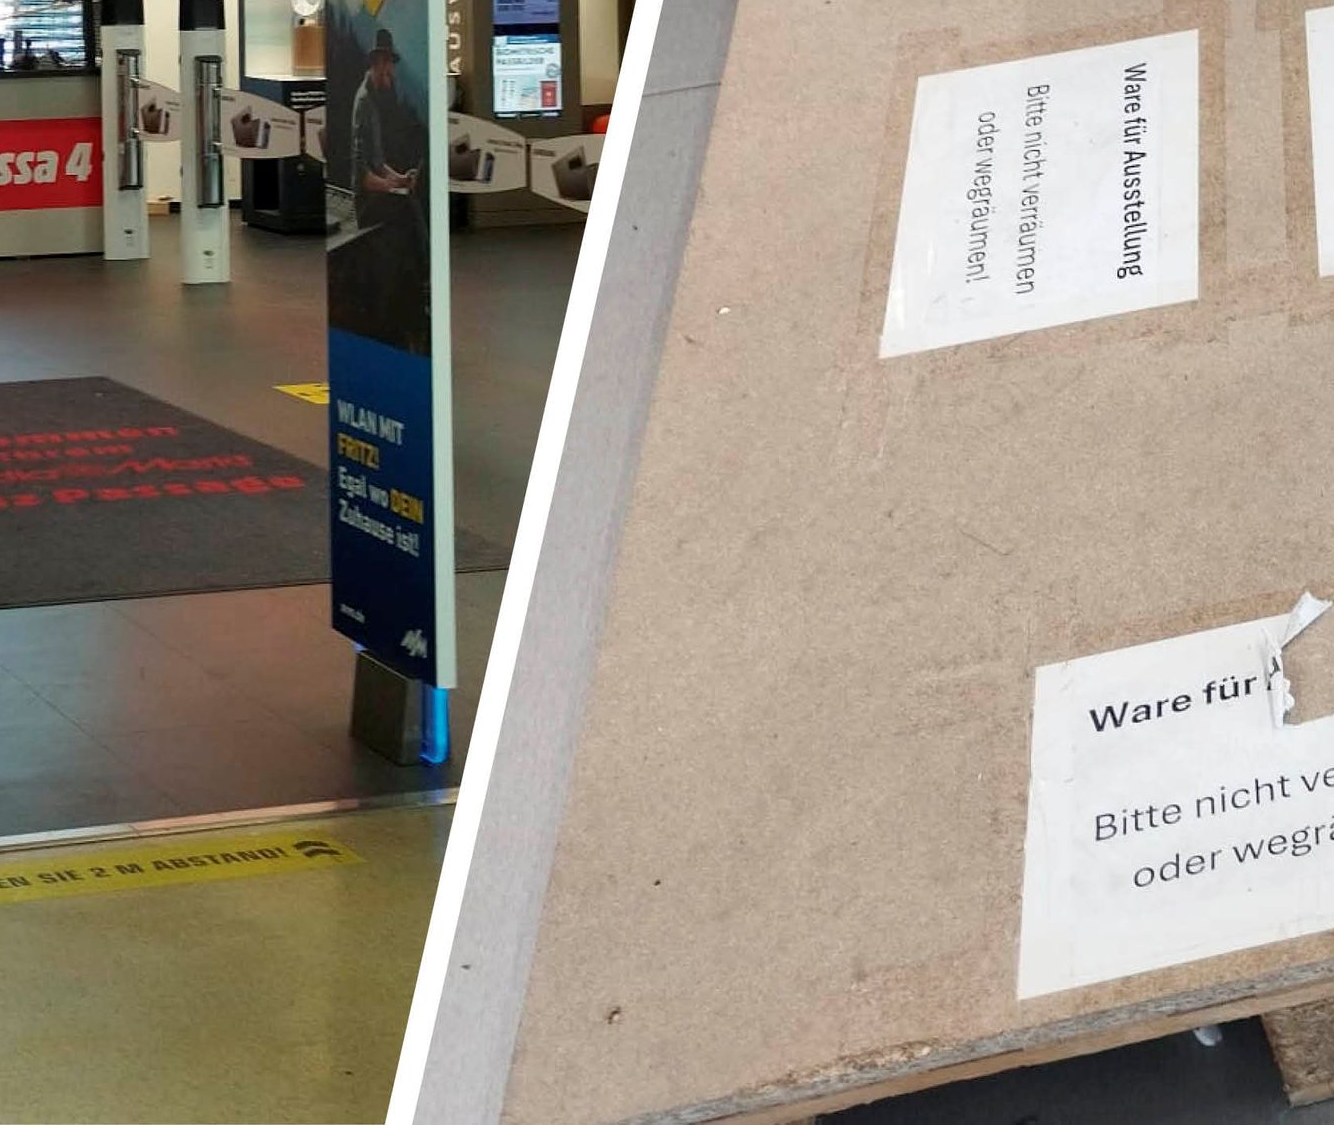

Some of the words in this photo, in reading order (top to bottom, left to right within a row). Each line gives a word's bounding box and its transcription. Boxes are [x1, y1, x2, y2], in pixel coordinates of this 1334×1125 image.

[1026, 83, 1050, 129] Bitte
[1122, 62, 1144, 109] Ware
[977, 111, 996, 150] oder
[1123, 113, 1144, 146] für
[66, 143, 92, 182] 4
[1023, 132, 1044, 182] nicht
[964, 153, 994, 284] wegräumen!
[1117, 149, 1144, 279] Ausstellung
[1013, 186, 1041, 295] verräumen
[337, 398, 377, 436] WLAN
[378, 415, 405, 446] MIT
[53, 475, 306, 504] Passage
[338, 465, 367, 499] Egal
[368, 484, 389, 509] wo
[390, 488, 424, 524] DEIN
[339, 498, 394, 545] Zuhause
[395, 525, 420, 558] ist!
[1089, 695, 1193, 733] Ware
[1201, 673, 1258, 703] für
[1094, 804, 1183, 843] Bitte
[1194, 774, 1292, 821] nicht
[38, 869, 80, 884] SIE
[91, 867, 108, 878] 2
[115, 862, 144, 875] M
[150, 846, 288, 871] ABSTAND!
[1132, 848, 1224, 890] oder
